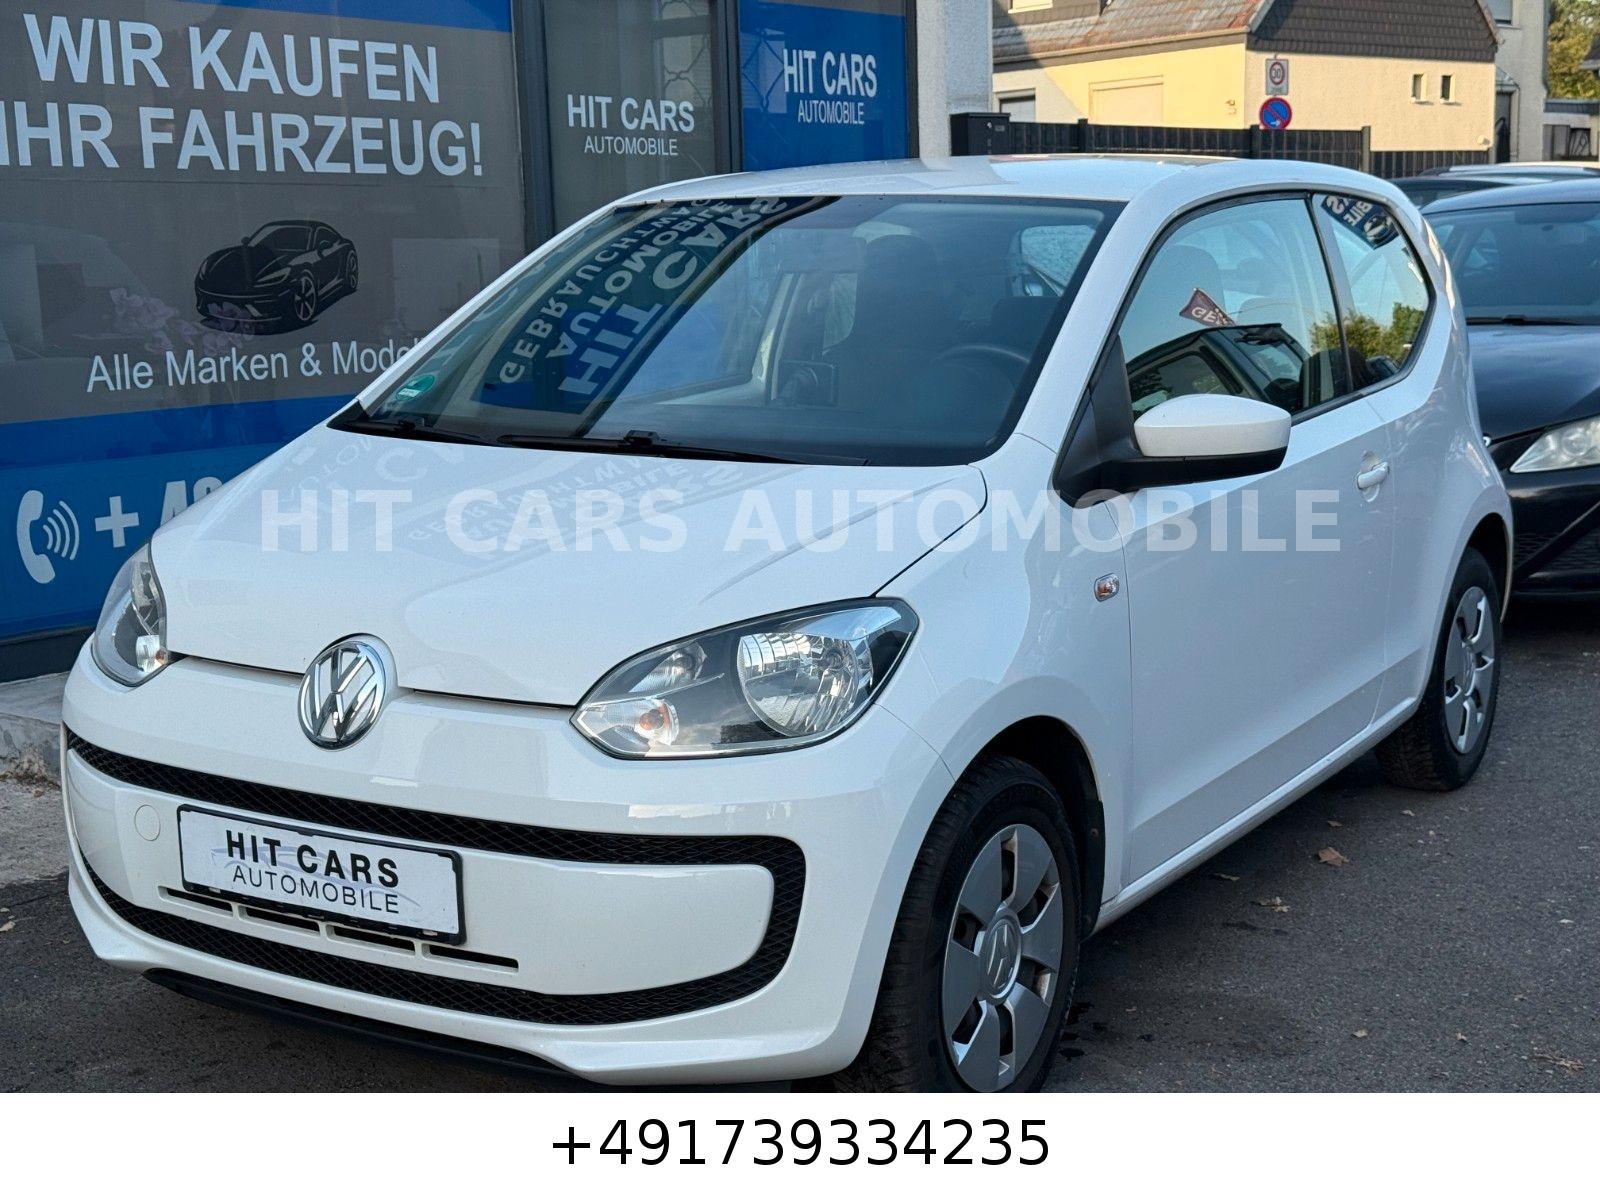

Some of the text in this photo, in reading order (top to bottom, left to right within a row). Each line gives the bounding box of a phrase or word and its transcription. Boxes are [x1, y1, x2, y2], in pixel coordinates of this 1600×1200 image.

[23, 13, 440, 103] WIR KAUFEN
[783, 48, 878, 98] HIT CARS
[567, 94, 695, 133] HIT CARS
[798, 99, 865, 126] AUTOMOBILE
[139, 106, 483, 176] FAHRZEUG!
[584, 135, 678, 157] AUTOMOBILE
[86, 355, 154, 393] Alle
[167, 347, 288, 386] Marken
[300, 342, 322, 377] &
[226, 830, 399, 889] HIT CARS
[233, 865, 399, 914] AUTOMOBILE
